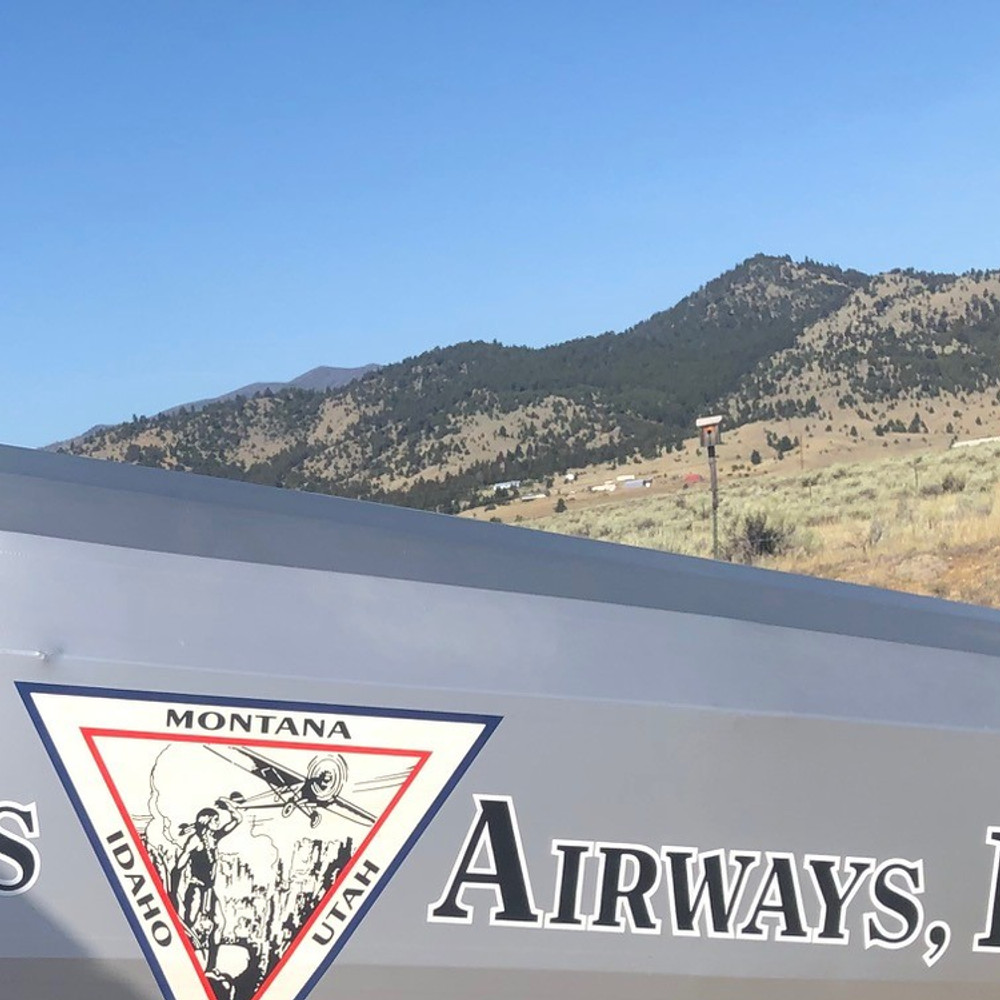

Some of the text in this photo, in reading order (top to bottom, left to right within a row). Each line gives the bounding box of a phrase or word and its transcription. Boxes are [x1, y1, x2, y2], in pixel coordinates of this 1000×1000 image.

[166, 708, 352, 740] MONTANA
[105, 830, 174, 948] IDAHO
[311, 859, 381, 947] UTAH
[429, 796, 950, 966] AIRWAYS,
